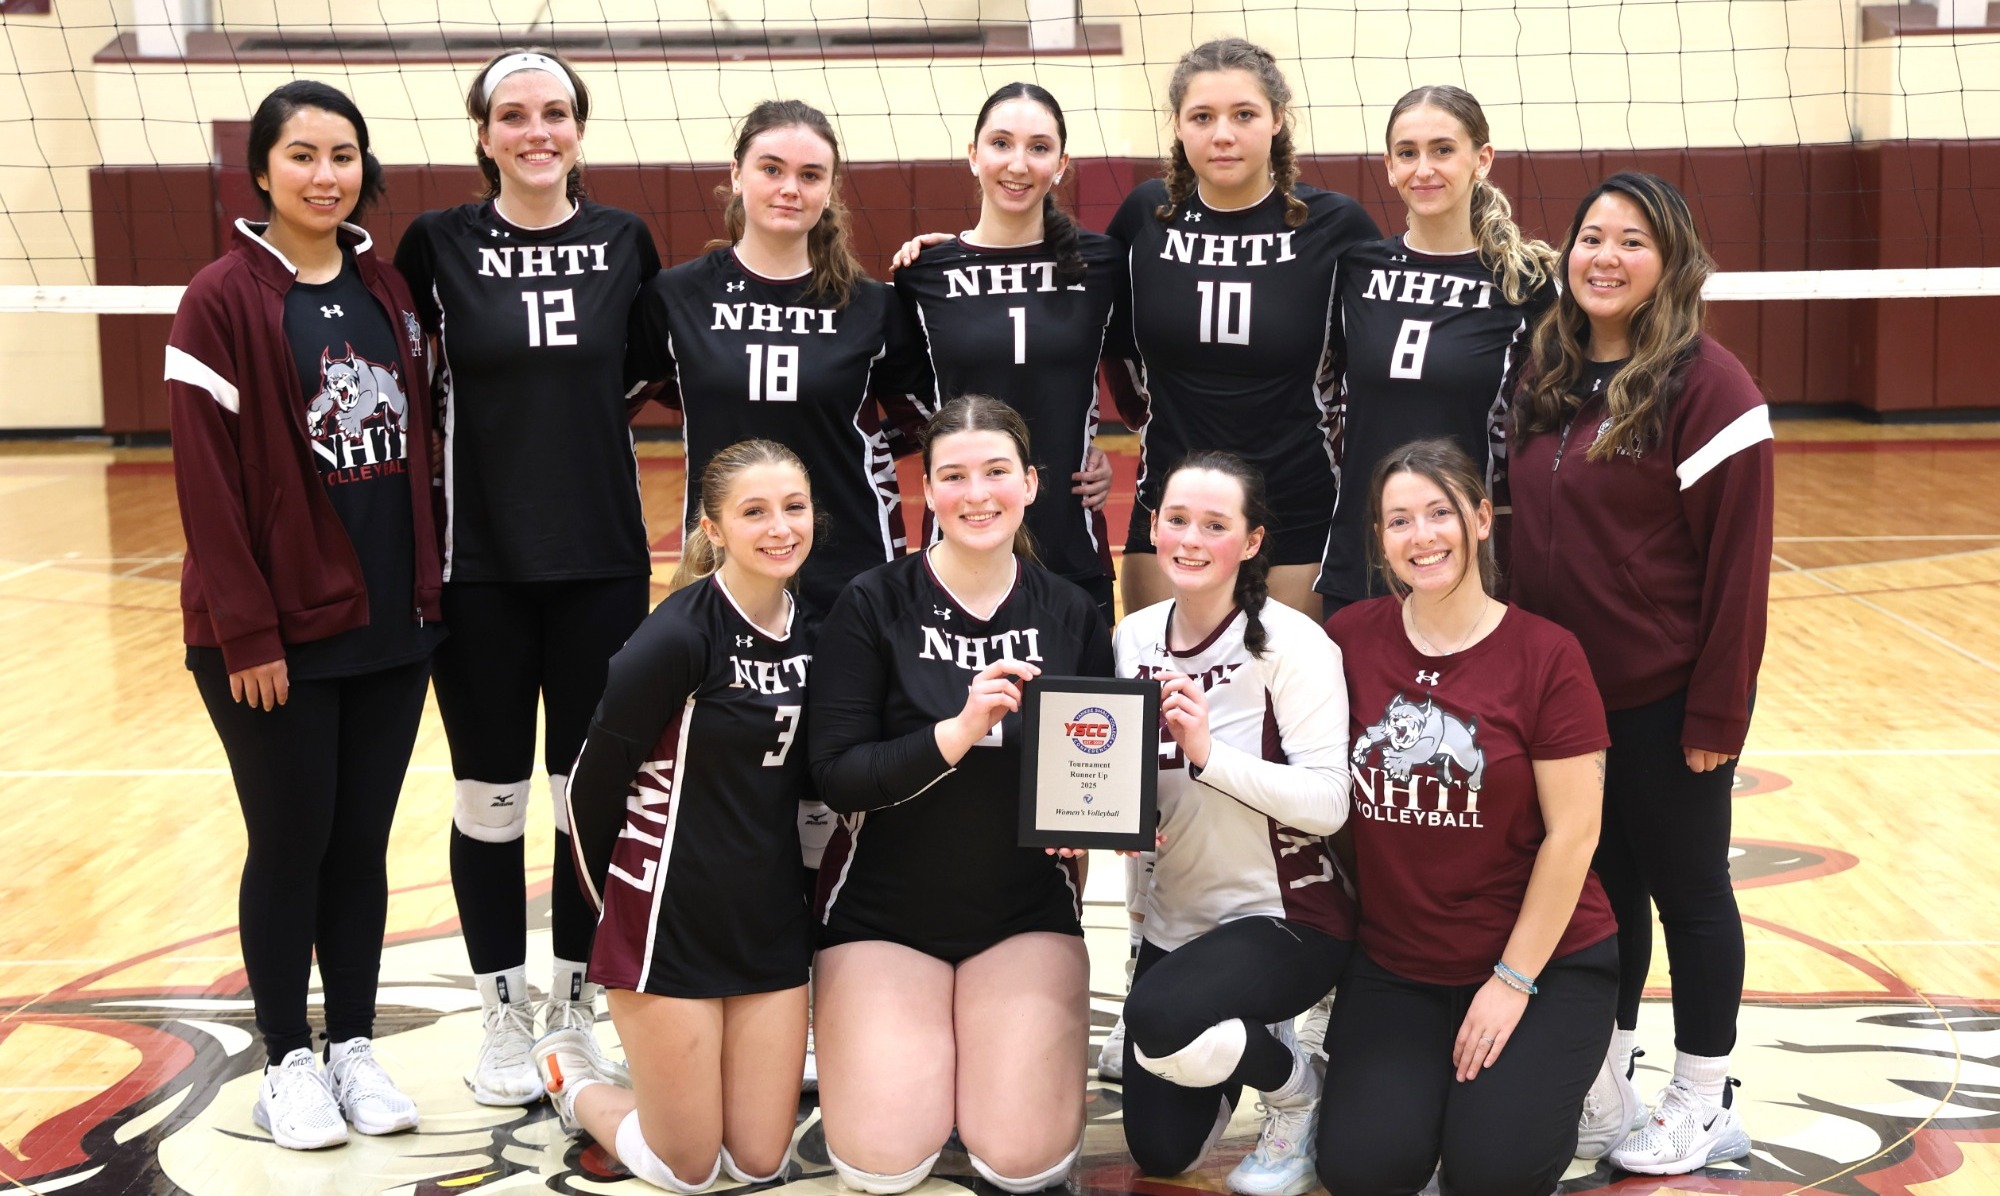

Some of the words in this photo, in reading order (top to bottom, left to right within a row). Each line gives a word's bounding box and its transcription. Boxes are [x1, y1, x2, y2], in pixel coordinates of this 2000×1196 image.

[478, 242, 609, 278] NHTI
[1160, 228, 1297, 267] NHTI
[943, 262, 1089, 298] NHT
[1362, 269, 1497, 309] NHTI
[521, 288, 578, 347] 12
[711, 302, 838, 334] NHTI
[1197, 280, 1252, 346] 10
[1008, 307, 1026, 364] 1
[1389, 319, 1433, 380] 8
[745, 344, 799, 401] 18
[919, 625, 1043, 671] NHTI
[728, 655, 813, 695] NHT
[762, 705, 802, 767] 3
[1064, 723, 1109, 737] YSCC
[1068, 760, 1111, 769] Tournament
[1098, 772, 1108, 780] Up
[1055, 808, 1085, 816] Women's
[1087, 809, 1120, 818] Volleyball
